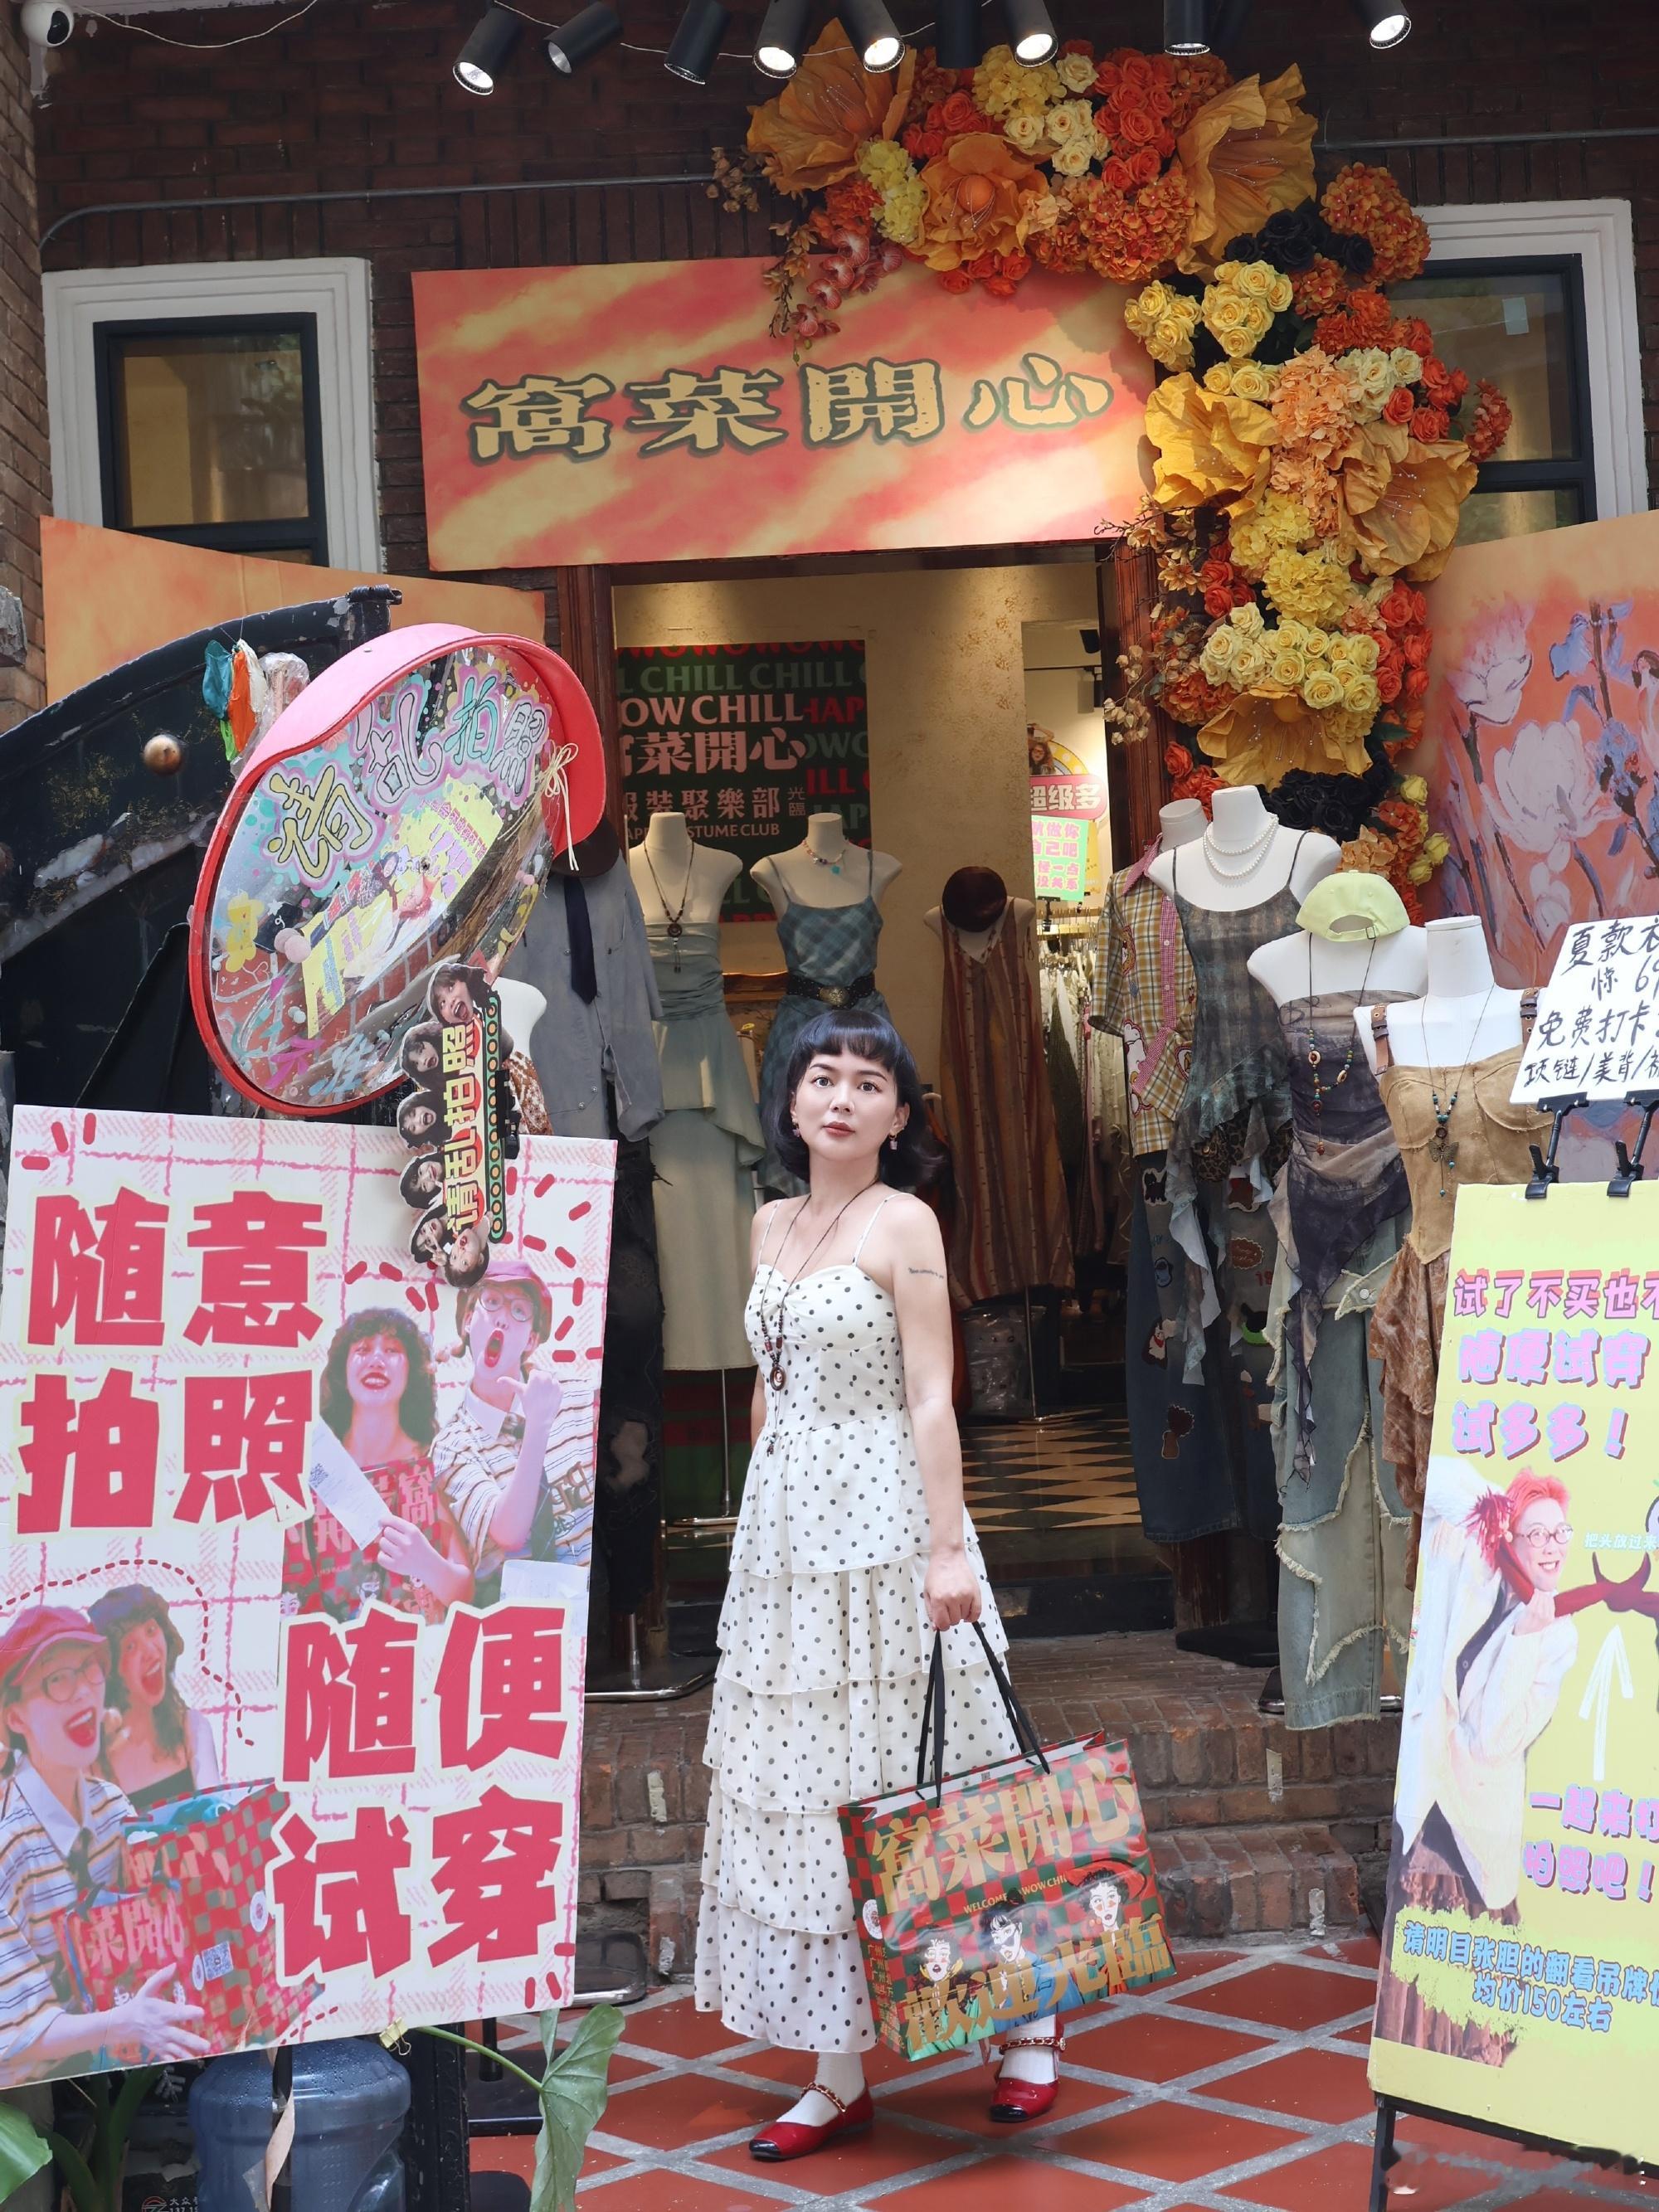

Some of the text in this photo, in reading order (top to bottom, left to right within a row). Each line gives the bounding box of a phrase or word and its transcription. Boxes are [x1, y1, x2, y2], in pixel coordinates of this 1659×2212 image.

[462, 354, 1112, 461] 窩菜開心
[640, 664, 743, 693] CHILL
[750, 661, 852, 690] CHILL
[691, 693, 804, 725] CHILL
[742, 822, 781, 837] CLUB
[1537, 999, 1659, 1052] 免费打卡
[442, 1021, 479, 1232] 请乱拍照
[27, 1185, 328, 1348] 随意
[17, 1368, 314, 1534] 拍照
[282, 1606, 567, 1783] 随便
[272, 1785, 564, 1980] 试穿
[1473, 1971, 1613, 2033] 均价150左右
